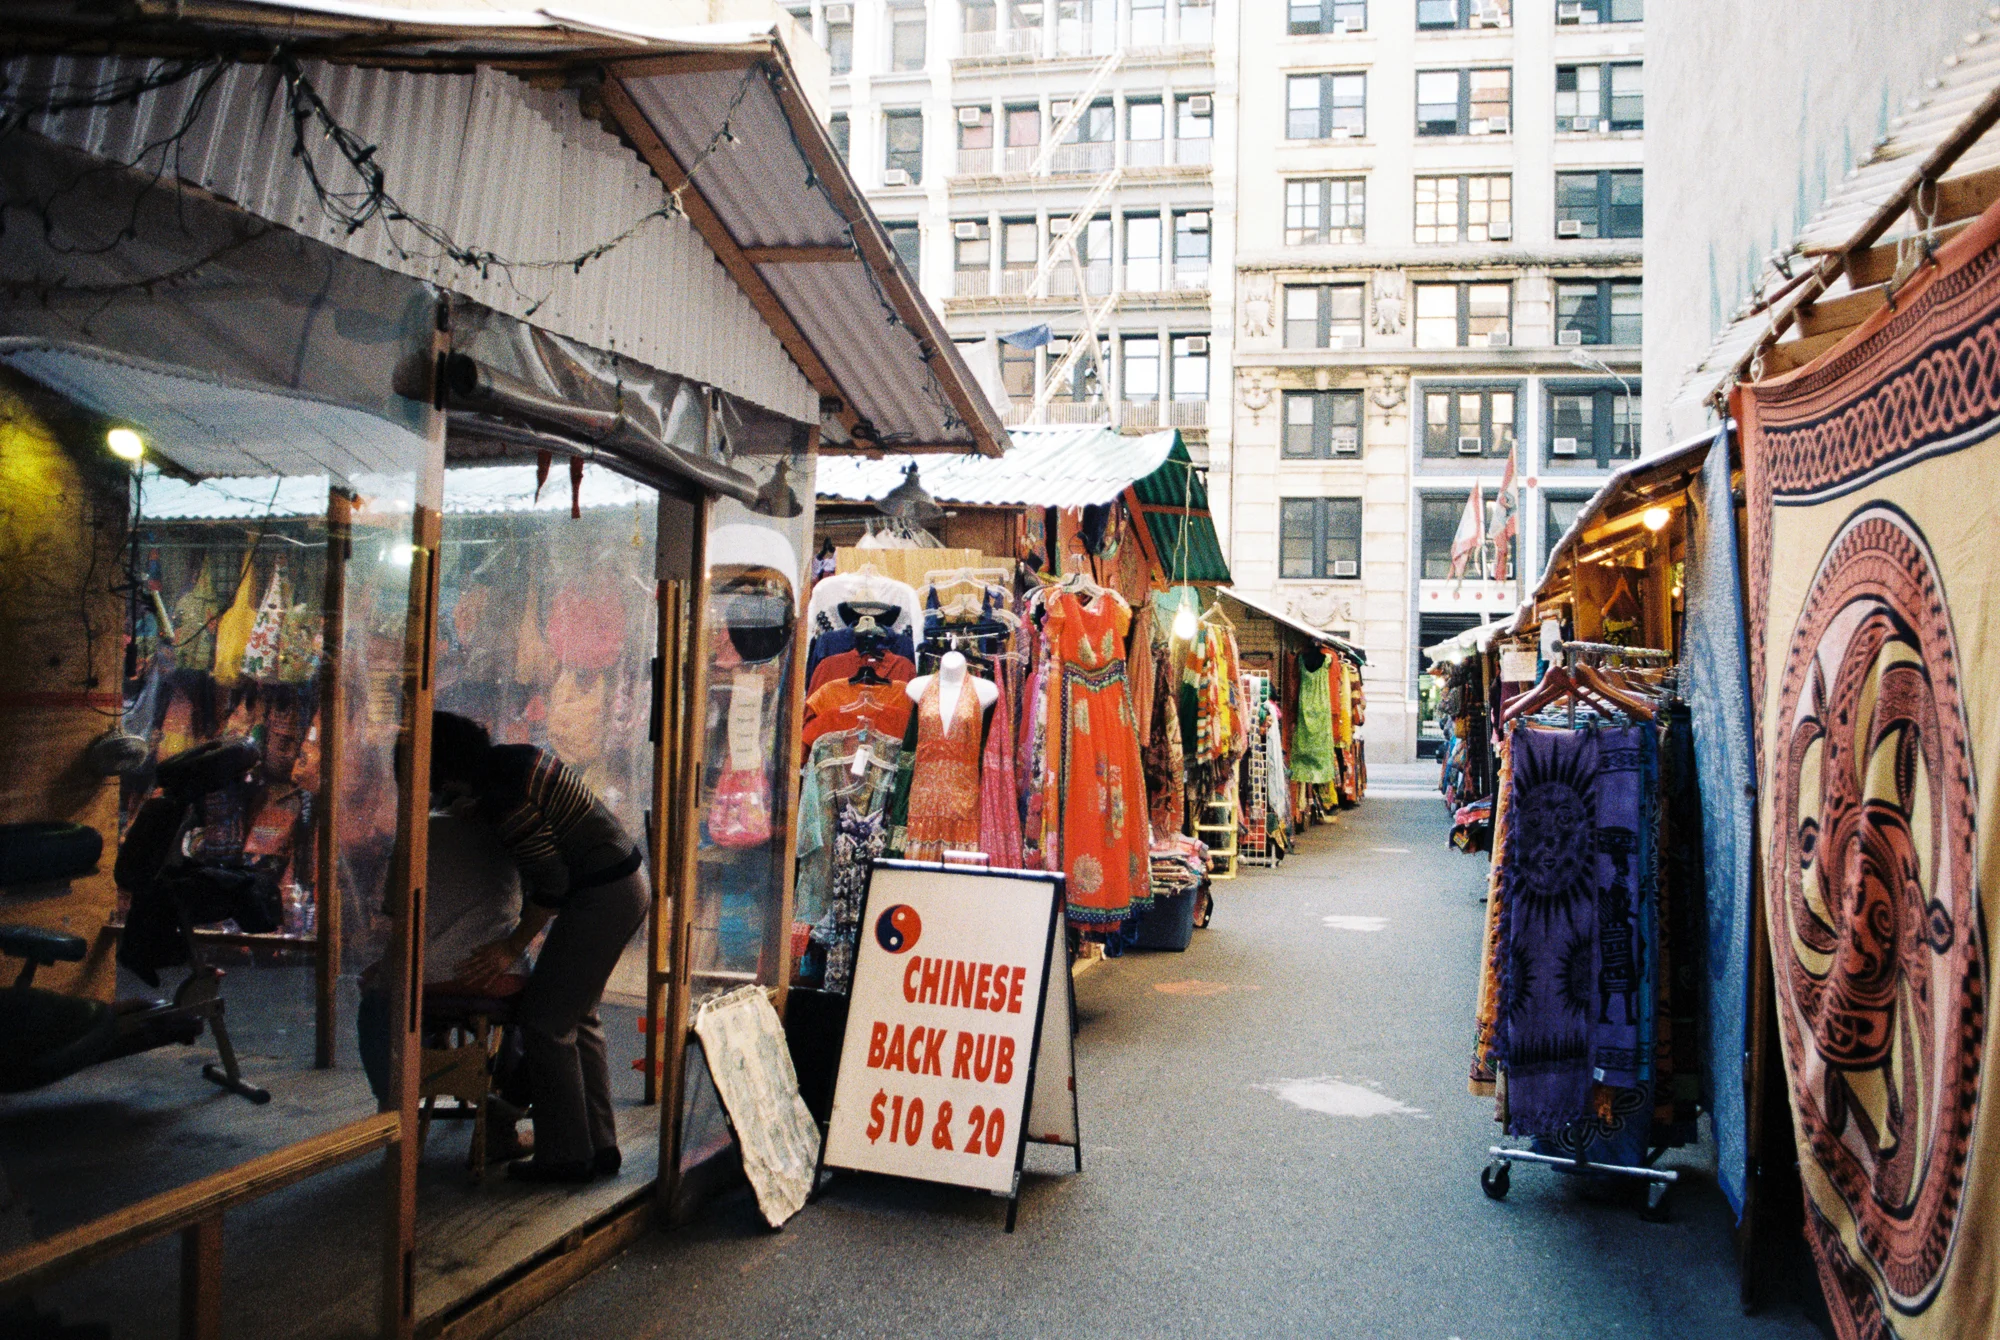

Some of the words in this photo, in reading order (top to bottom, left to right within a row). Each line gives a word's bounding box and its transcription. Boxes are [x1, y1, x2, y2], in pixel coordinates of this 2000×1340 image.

[902, 955, 1026, 1015] CHINESE
[867, 1021, 948, 1077] BACK
[952, 1031, 1016, 1085] RUB
[865, 1088, 925, 1147] $10
[932, 1100, 955, 1151] &
[963, 1105, 1006, 1158] 20
